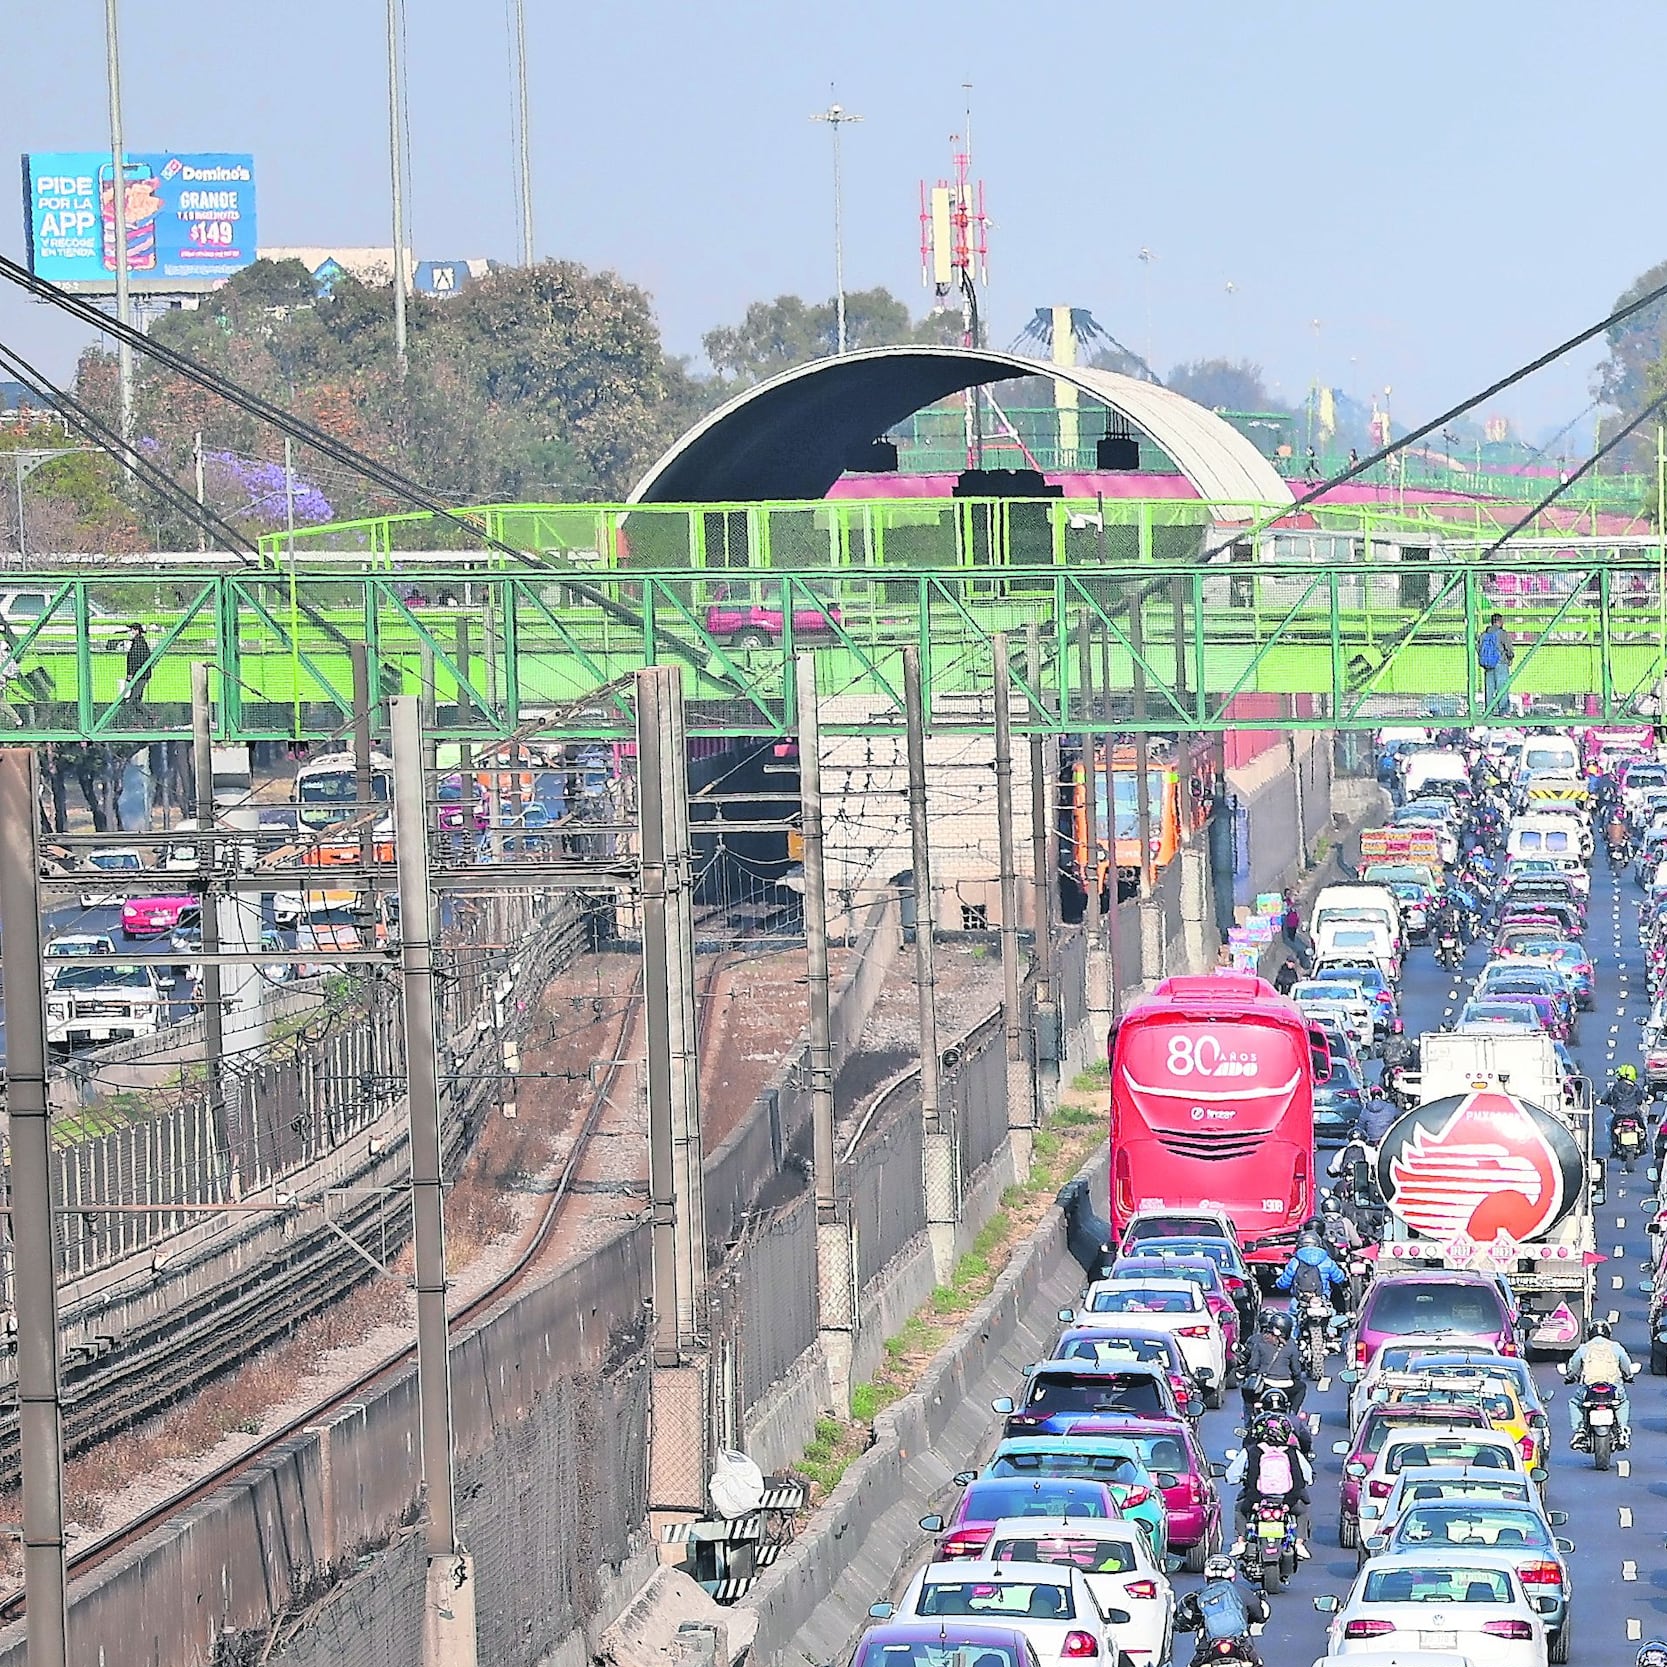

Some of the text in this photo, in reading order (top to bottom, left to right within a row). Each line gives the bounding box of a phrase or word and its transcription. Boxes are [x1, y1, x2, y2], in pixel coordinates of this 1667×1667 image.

[182, 166, 250, 182] Domino's
[38, 177, 93, 196] PIDE
[38, 198, 93, 210] POR LA
[181, 191, 238, 209] GRANDE
[40, 212, 96, 237] APP
[190, 222, 234, 245] $149
[1167, 1035, 1221, 1077] 80
